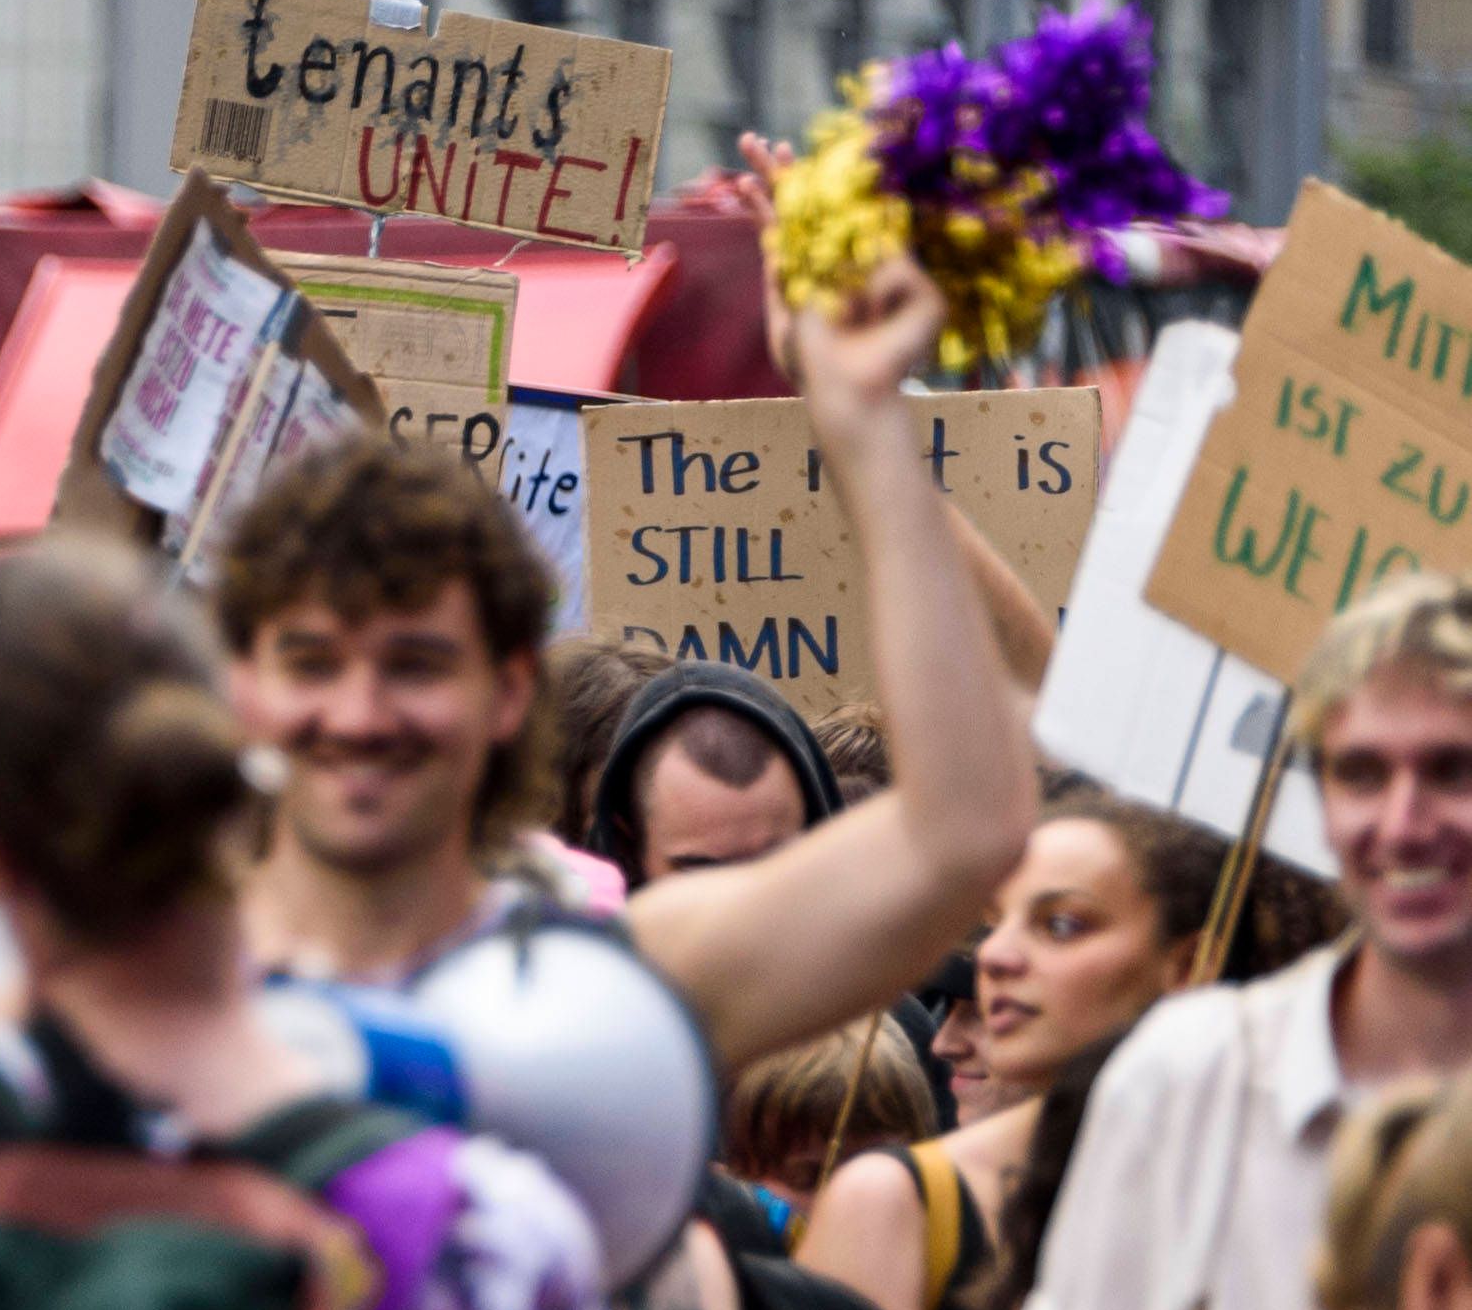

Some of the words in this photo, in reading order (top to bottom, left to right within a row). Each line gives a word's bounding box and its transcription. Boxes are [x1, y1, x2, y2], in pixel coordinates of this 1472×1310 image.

[617, 431, 760, 496] The
[1013, 434, 1074, 495] is
[1275, 375, 1364, 456] IST
[1380, 441, 1471, 525] ZU
[626, 524, 805, 586] STILL
